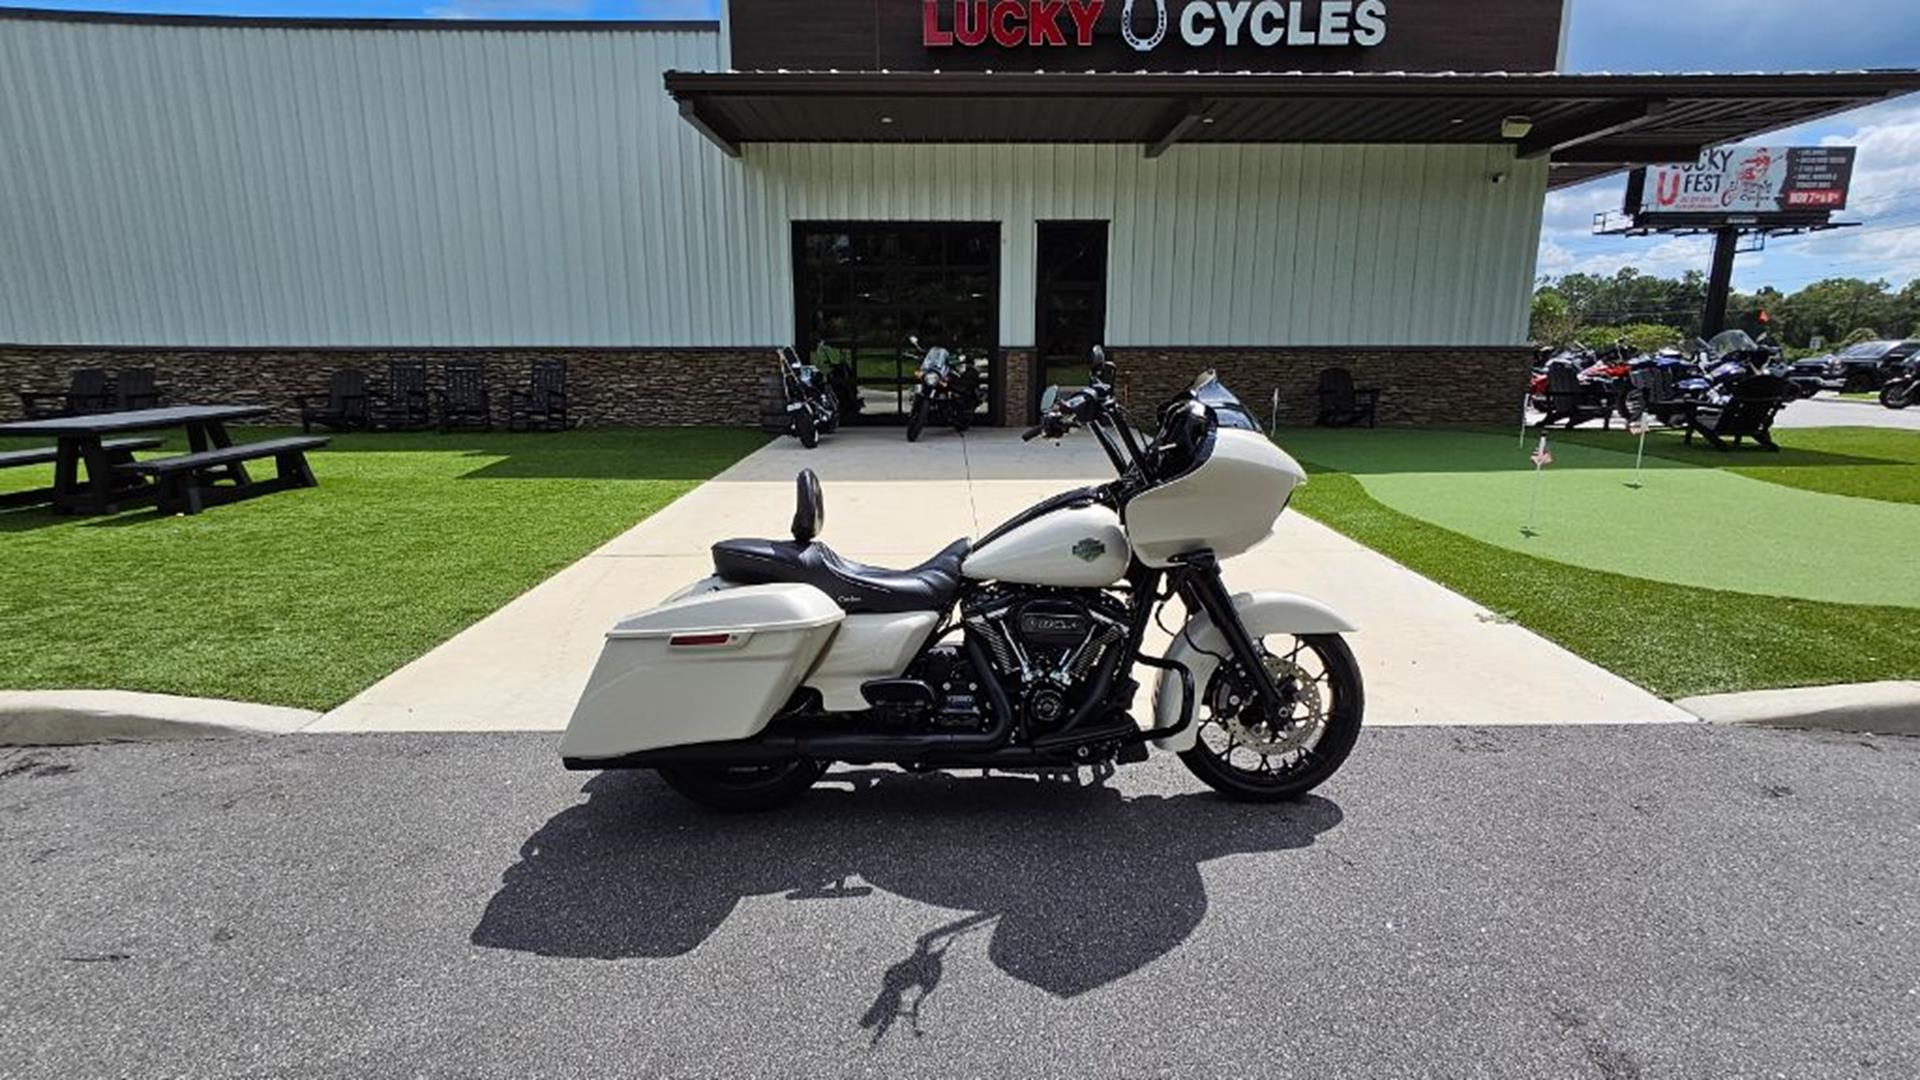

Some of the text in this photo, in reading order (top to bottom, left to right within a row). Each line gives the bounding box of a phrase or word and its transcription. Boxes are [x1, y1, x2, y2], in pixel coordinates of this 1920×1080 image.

[923, 0, 1387, 46] LUCKY CYCLES
[1671, 148, 1734, 173] CKY
[1683, 173, 1723, 194] FEST
